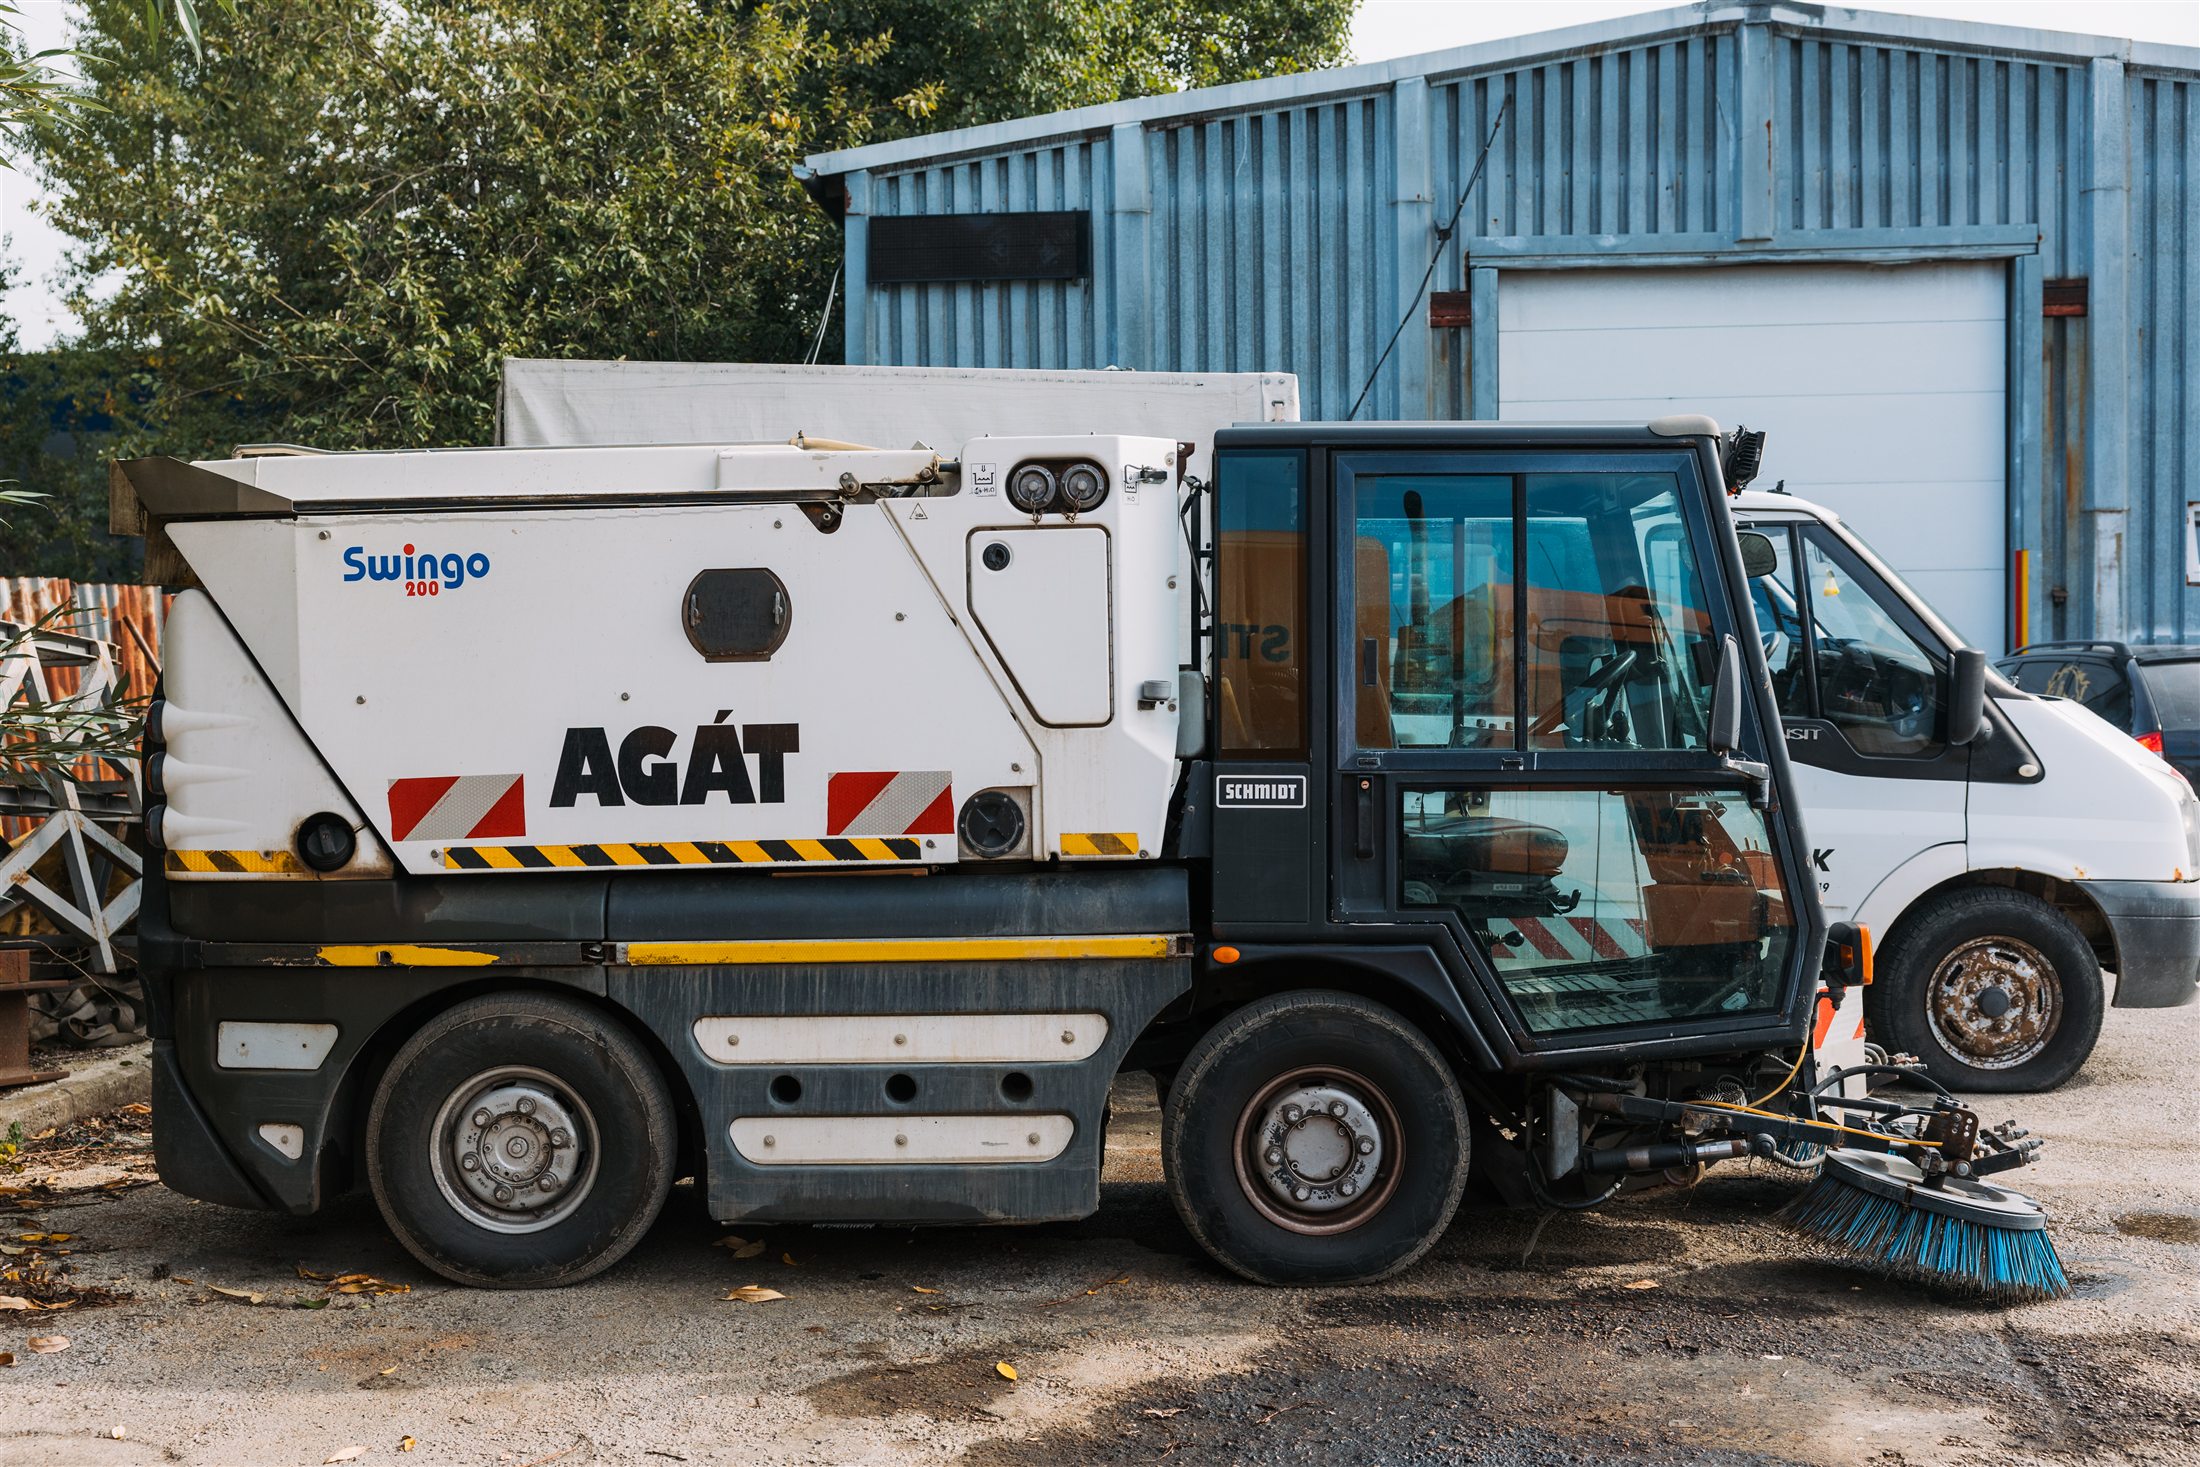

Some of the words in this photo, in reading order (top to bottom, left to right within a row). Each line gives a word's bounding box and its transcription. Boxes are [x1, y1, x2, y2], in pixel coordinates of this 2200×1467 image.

[343, 543, 490, 589] Swingo
[405, 581, 439, 597] 200
[549, 709, 800, 808] AGÁT
[1225, 783, 1297, 800] SCHMIDT
[1812, 848, 1835, 872] K
